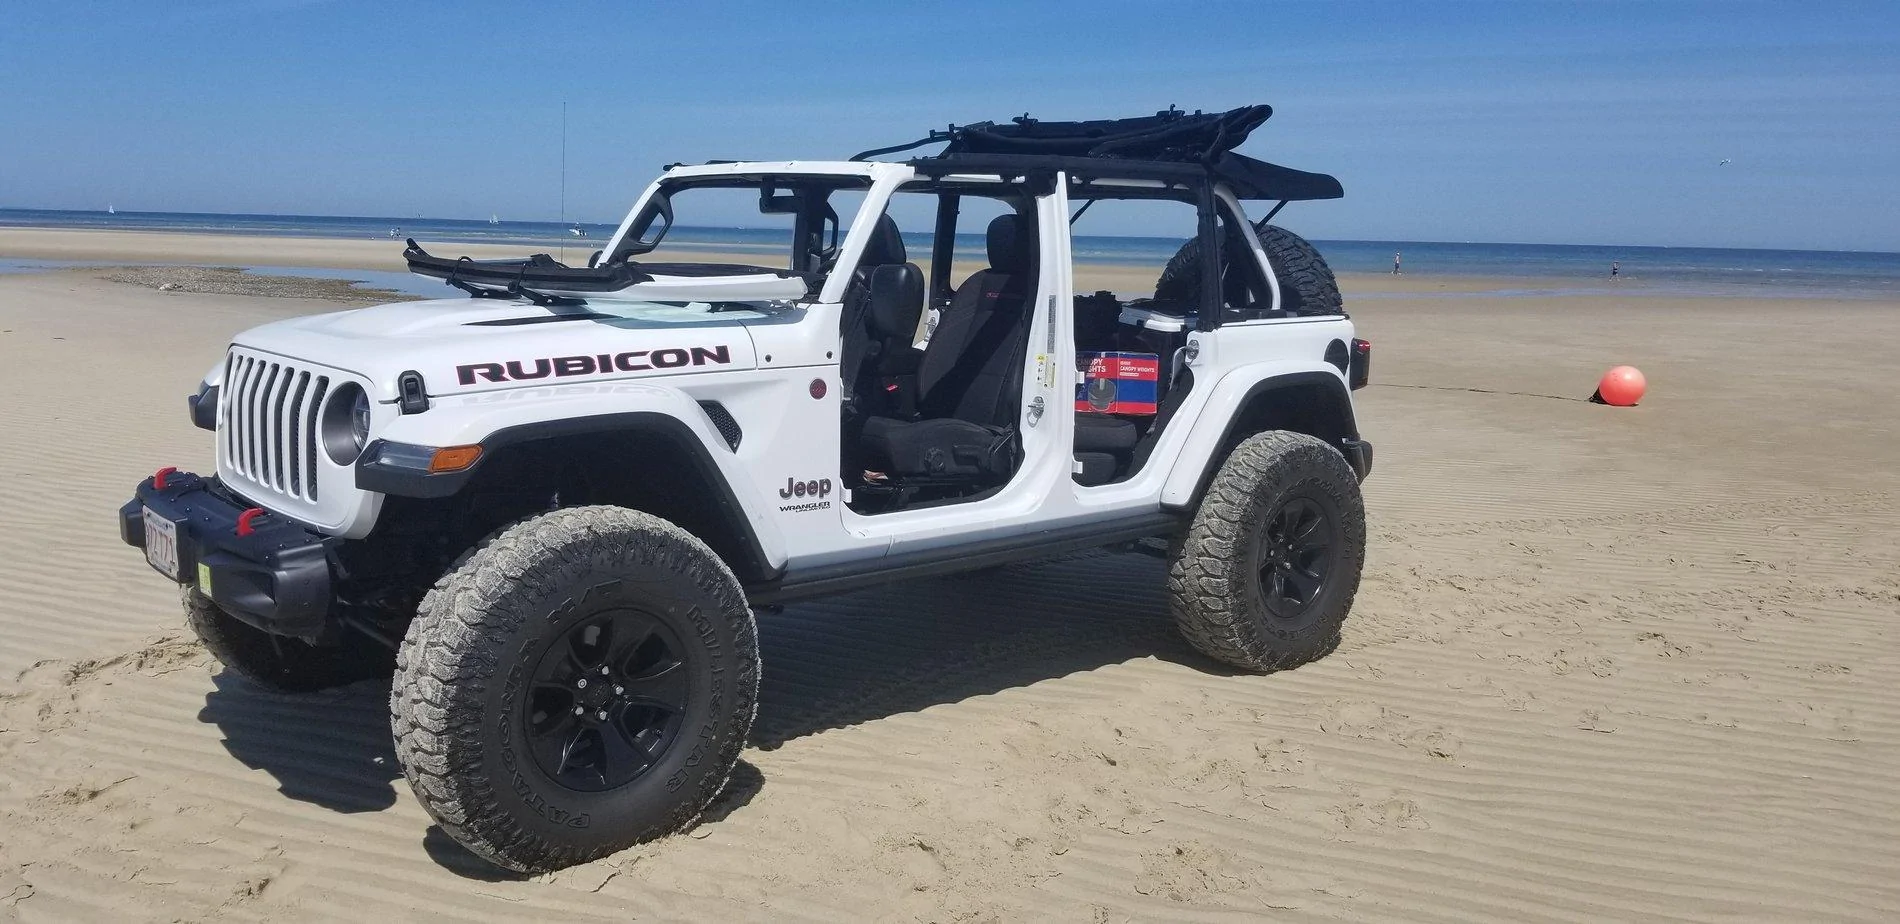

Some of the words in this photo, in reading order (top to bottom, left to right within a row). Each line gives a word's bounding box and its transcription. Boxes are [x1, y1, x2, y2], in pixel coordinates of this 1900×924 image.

[455, 344, 731, 386] RUBICON
[1120, 365, 1137, 373] CANOPY
[779, 477, 832, 500] Jeep
[779, 501, 831, 512] WRANGLER
